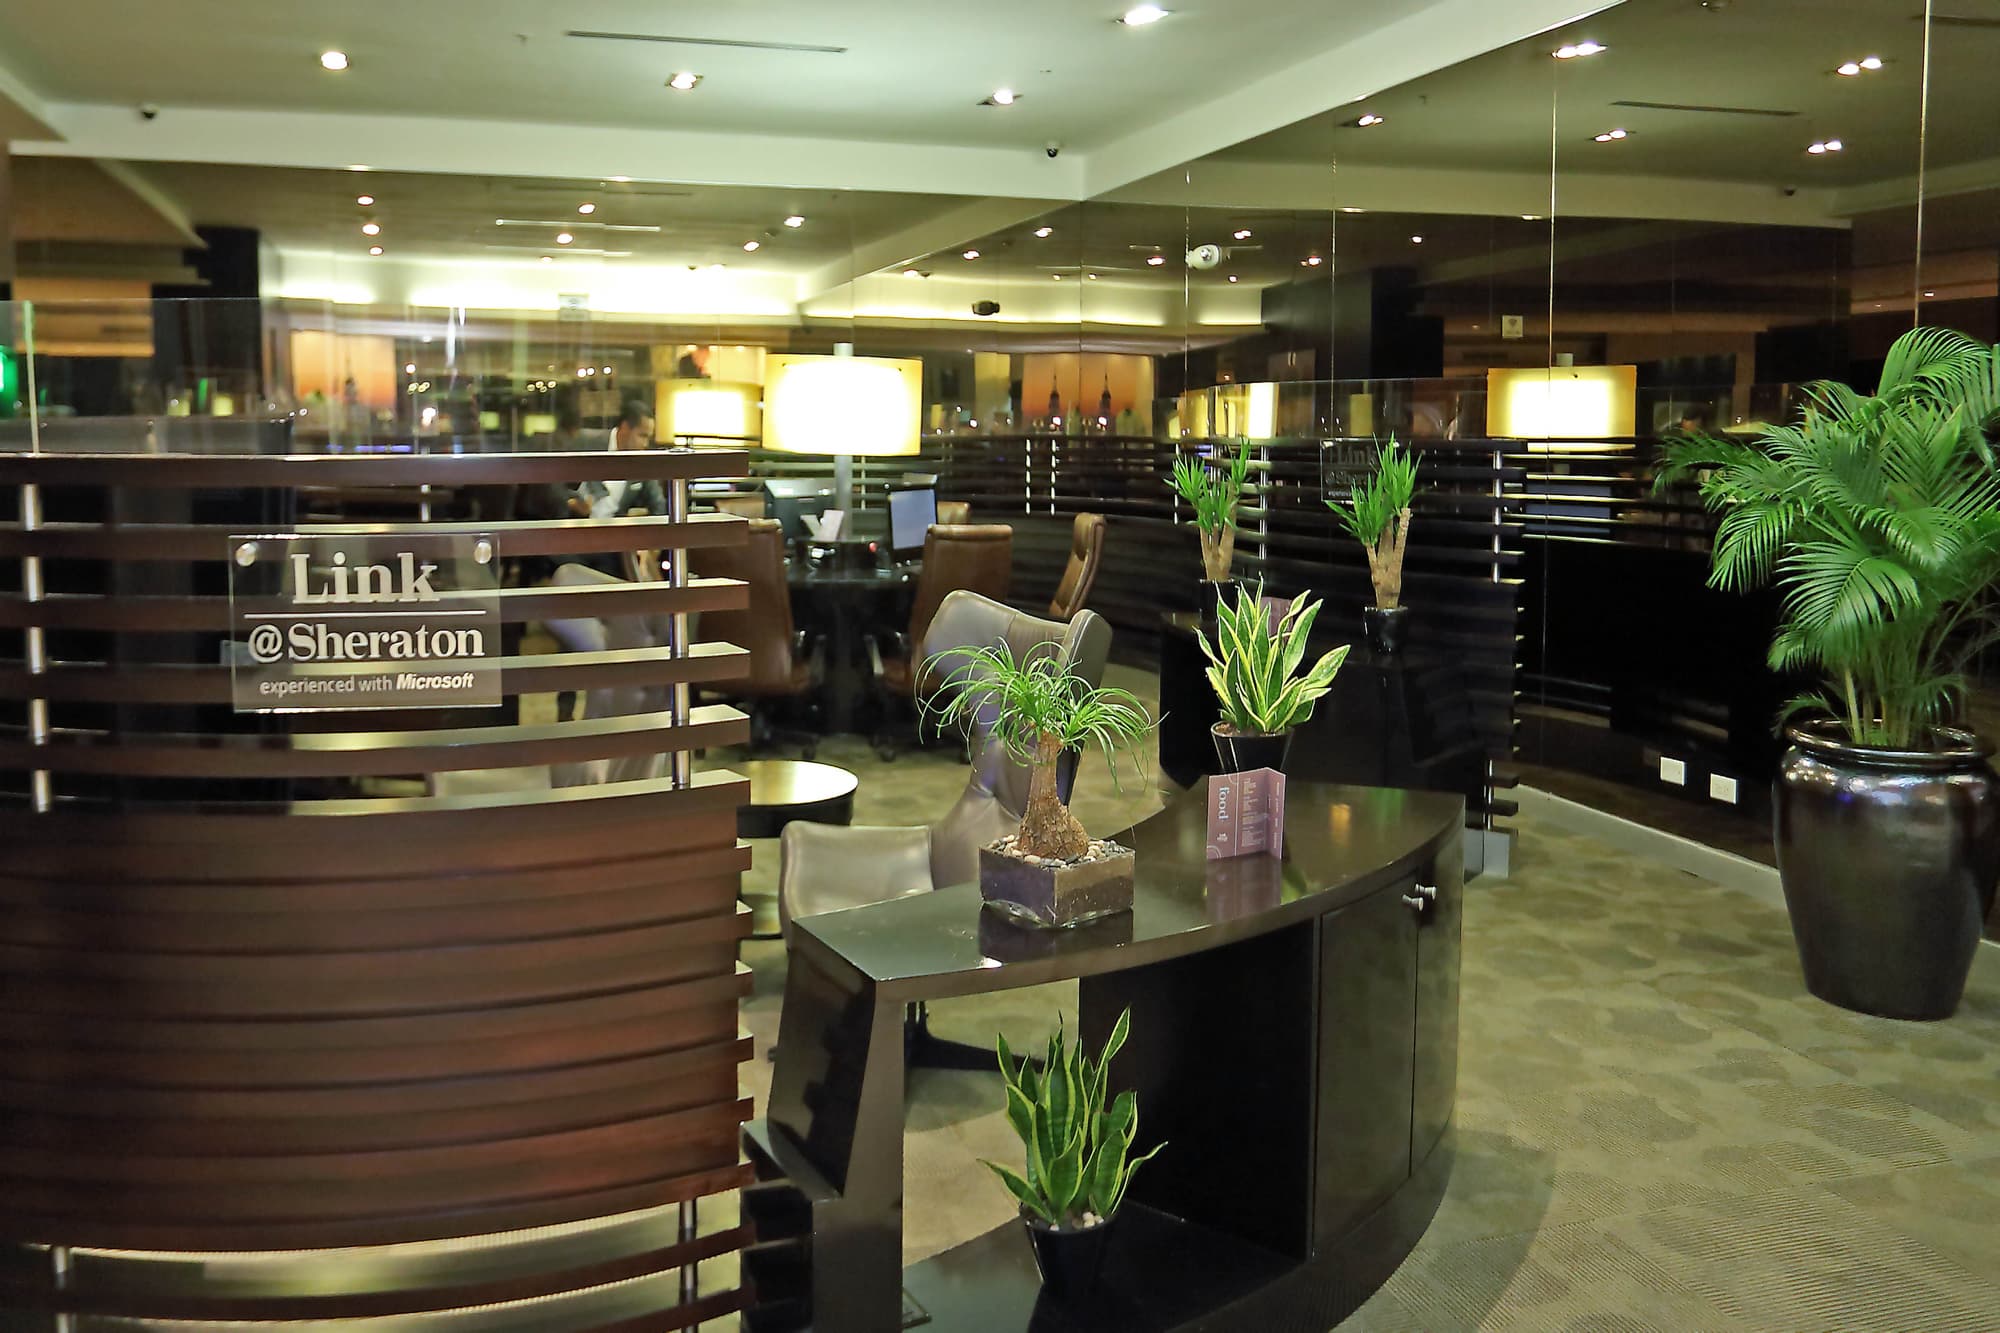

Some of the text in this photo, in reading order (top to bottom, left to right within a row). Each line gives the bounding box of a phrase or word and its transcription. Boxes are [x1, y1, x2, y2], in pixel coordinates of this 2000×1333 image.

[291, 552, 441, 604] Link
[248, 623, 486, 663] @Sheraton
[260, 672, 474, 698] experienced with Microsoft
[1218, 787, 1230, 820] food
